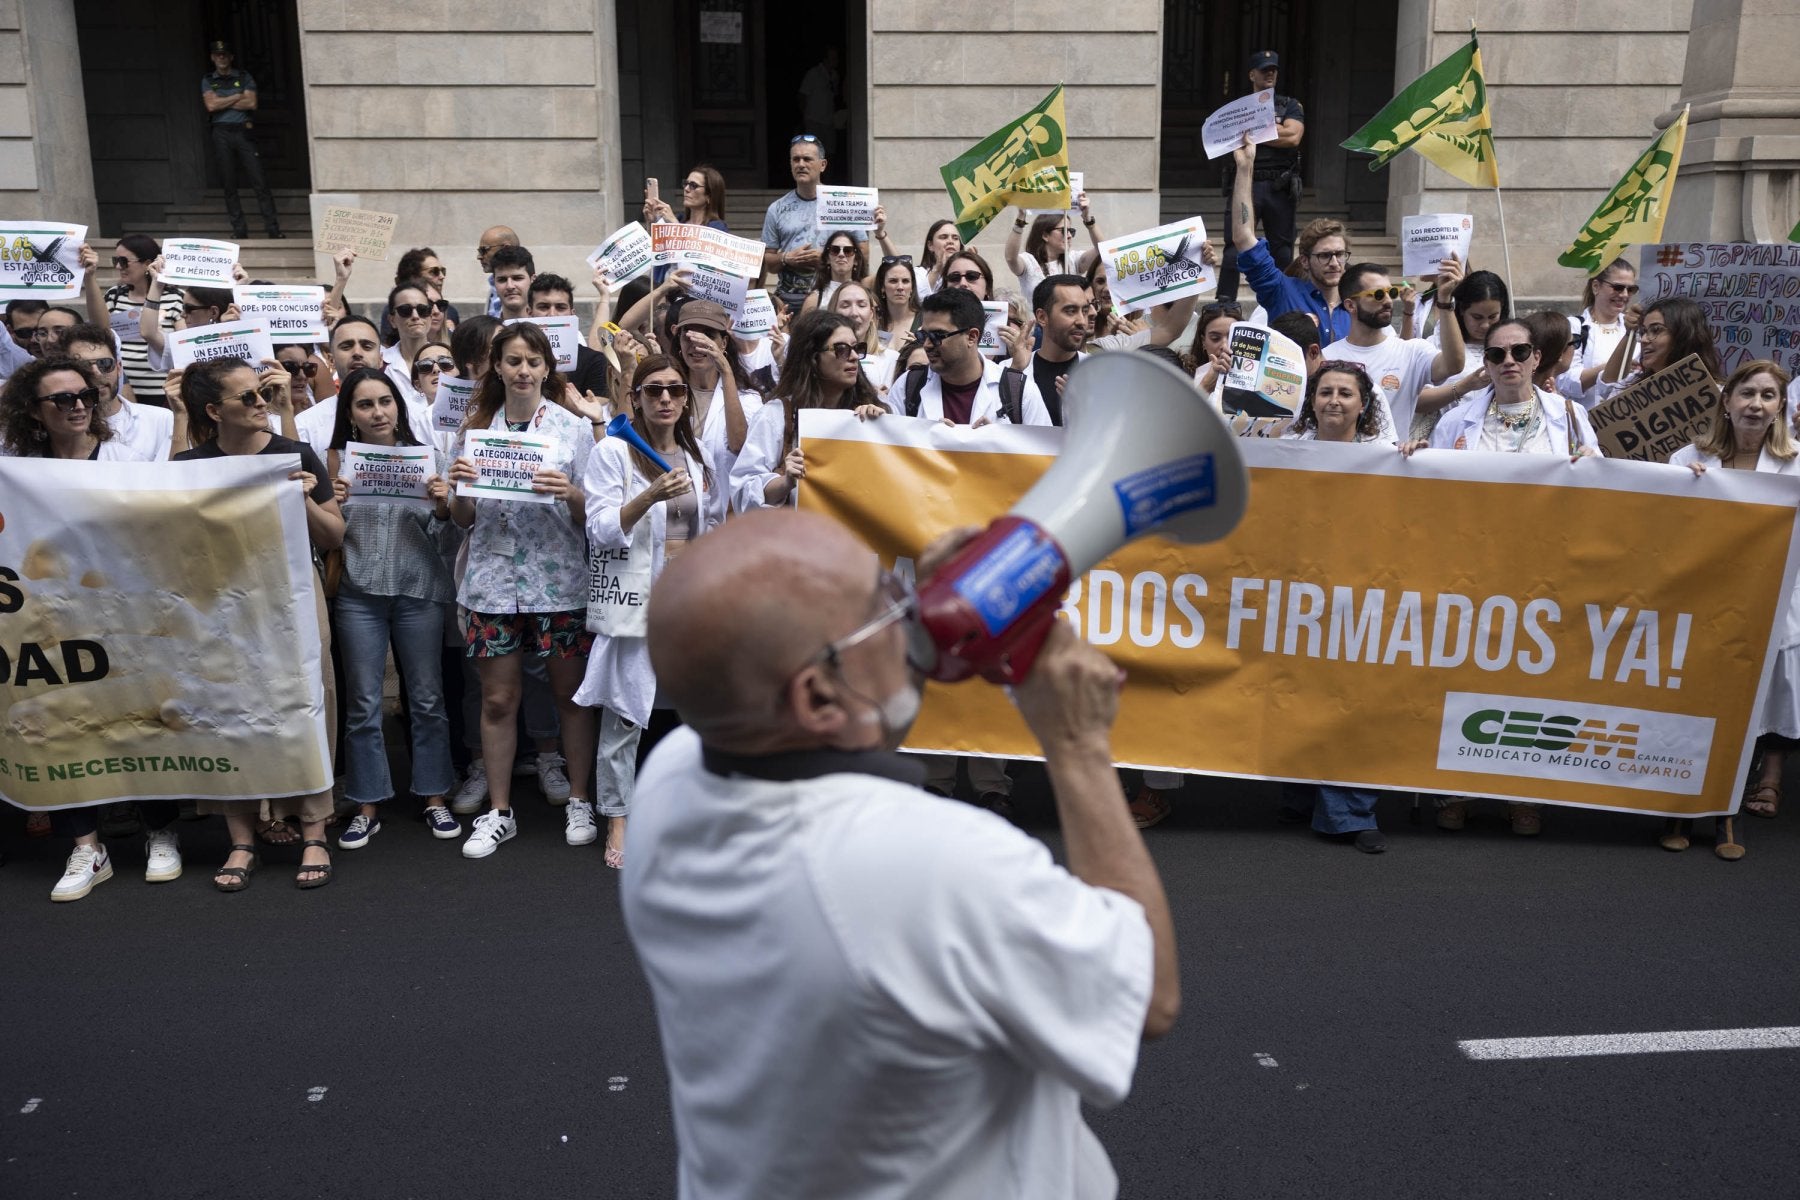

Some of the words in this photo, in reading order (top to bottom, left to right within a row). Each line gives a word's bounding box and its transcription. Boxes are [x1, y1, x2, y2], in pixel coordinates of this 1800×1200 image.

[655, 225, 699, 239] ¡HUELGA!
[665, 238, 702, 251] MÉDICOS
[197, 256, 232, 264] CONCURSO
[1114, 250, 1139, 270] ¡NO
[1146, 244, 1163, 260] AL
[4, 262, 59, 272] ESTATUTO
[188, 266, 220, 276] MÉRITOS
[1117, 255, 1166, 281] NUEVO
[1140, 260, 1188, 282] ESTATUTO
[24, 273, 71, 284] MARCO!
[702, 274, 730, 288] ESTATUTO
[1157, 267, 1200, 287] MARCO!
[692, 278, 713, 290] PROPIO
[714, 285, 730, 295] PARA
[1655, 272, 1800, 298] DEFENDEMO
[280, 304, 319, 312] CONCURSO
[747, 305, 771, 315] CONCURSO
[270, 317, 308, 328] MÉRITOS
[740, 319, 766, 328] MÉRITOS
[1235, 329, 1266, 341] HUELGA
[193, 349, 206, 358] UN
[207, 343, 249, 355] ESTATUTO
[473, 448, 543, 462] CATEGORIZACIÓN
[354, 463, 424, 474] CATEGORIZACIÓN
[475, 458, 501, 468] MECES
[511, 461, 516, 469] Y
[520, 463, 540, 472] EFQ7
[356, 472, 383, 480] MECES
[481, 468, 533, 480] RETRIBUCIÓN
[362, 479, 416, 489] RETRIBUCIÓN
[610, 576, 620, 590] A
[1226, 577, 1561, 675] FIRMADOS
[1584, 603, 1693, 689] YA!
[1461, 709, 1640, 760] CESM
[1458, 746, 1542, 763] SINDICATO
[1548, 753, 1611, 770] MÉDICO
[1618, 762, 1692, 780] CANARIO
[1637, 753, 1694, 766] CANARIAS
[15, 763, 40, 782] TE
[47, 755, 240, 781] NECESITAMOS.
